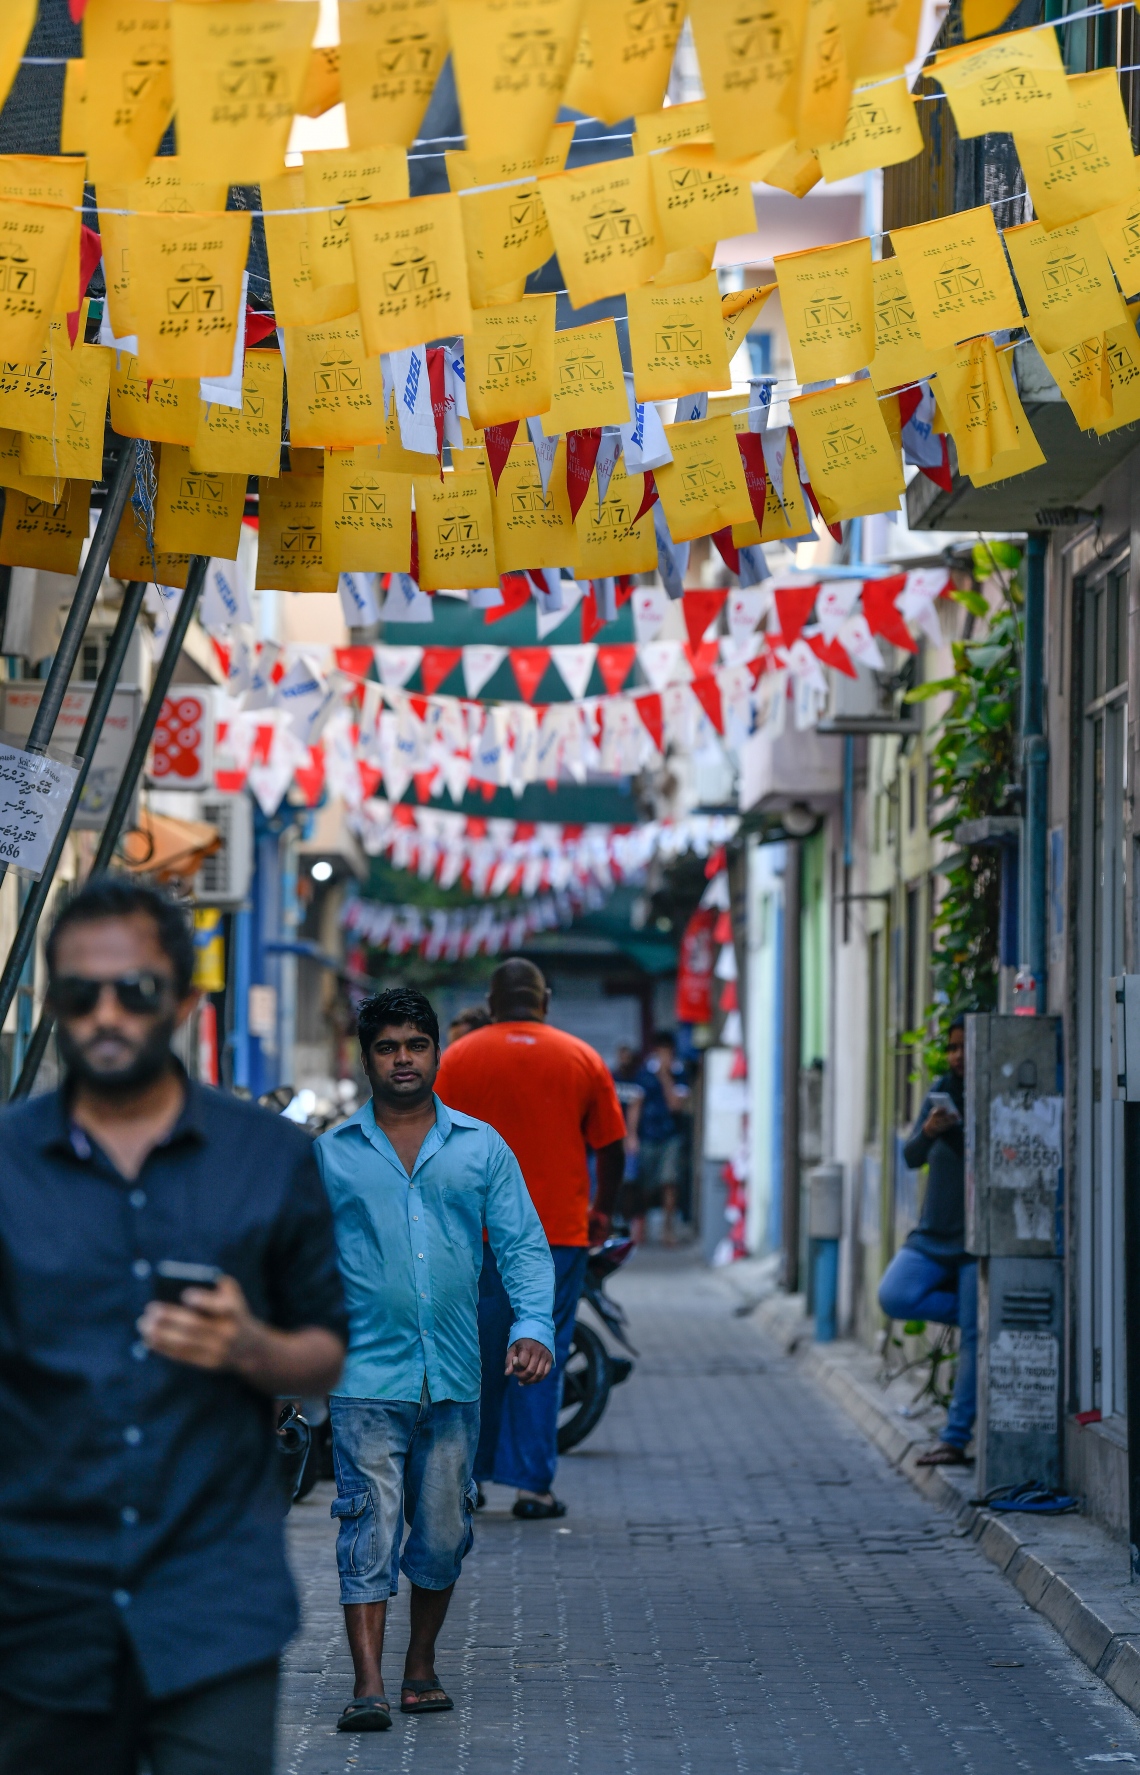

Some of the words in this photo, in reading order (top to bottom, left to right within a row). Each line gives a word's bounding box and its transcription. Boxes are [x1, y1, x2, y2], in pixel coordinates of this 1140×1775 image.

[1014, 74, 1026, 86] 7
[866, 111, 878, 123] 7
[619, 219, 631, 235] 7
[16, 272, 29, 290] 7
[418, 268, 429, 285] 7
[203, 290, 215, 309] 7
[1114, 352, 1123, 366] 7
[403, 351, 422, 415] FAZEEL
[616, 509, 625, 522] 7
[464, 525, 472, 538] 7
[307, 536, 316, 549] 7
